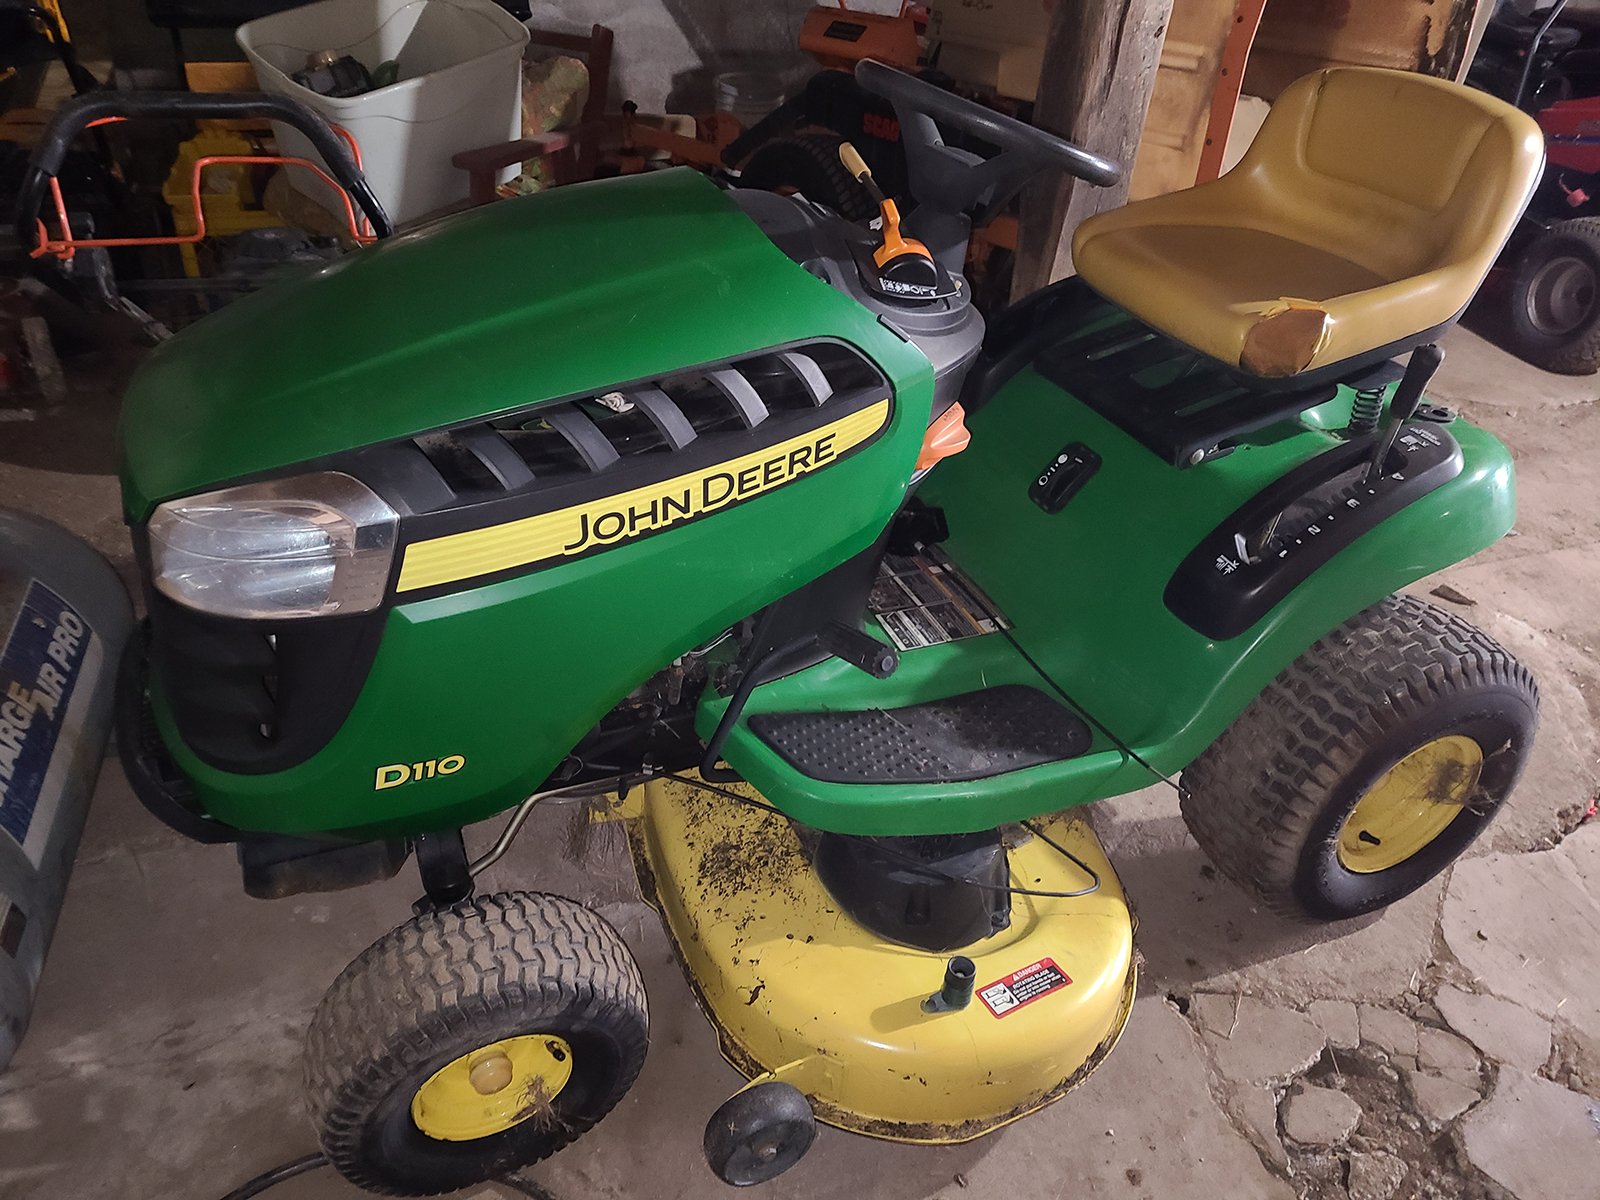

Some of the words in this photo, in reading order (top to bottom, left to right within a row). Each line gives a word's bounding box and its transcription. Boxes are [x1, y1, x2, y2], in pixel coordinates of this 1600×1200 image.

[564, 488, 691, 551] JOHN
[702, 432, 837, 508] DEERE
[1307, 524, 1321, 536] 2
[1346, 498, 1360, 509] 3
[47, 611, 84, 672] PRO
[31, 662, 68, 721] AIR
[0, 680, 38, 808] ARGE
[375, 754, 466, 791] D110
[1016, 963, 1042, 978] DANGER
